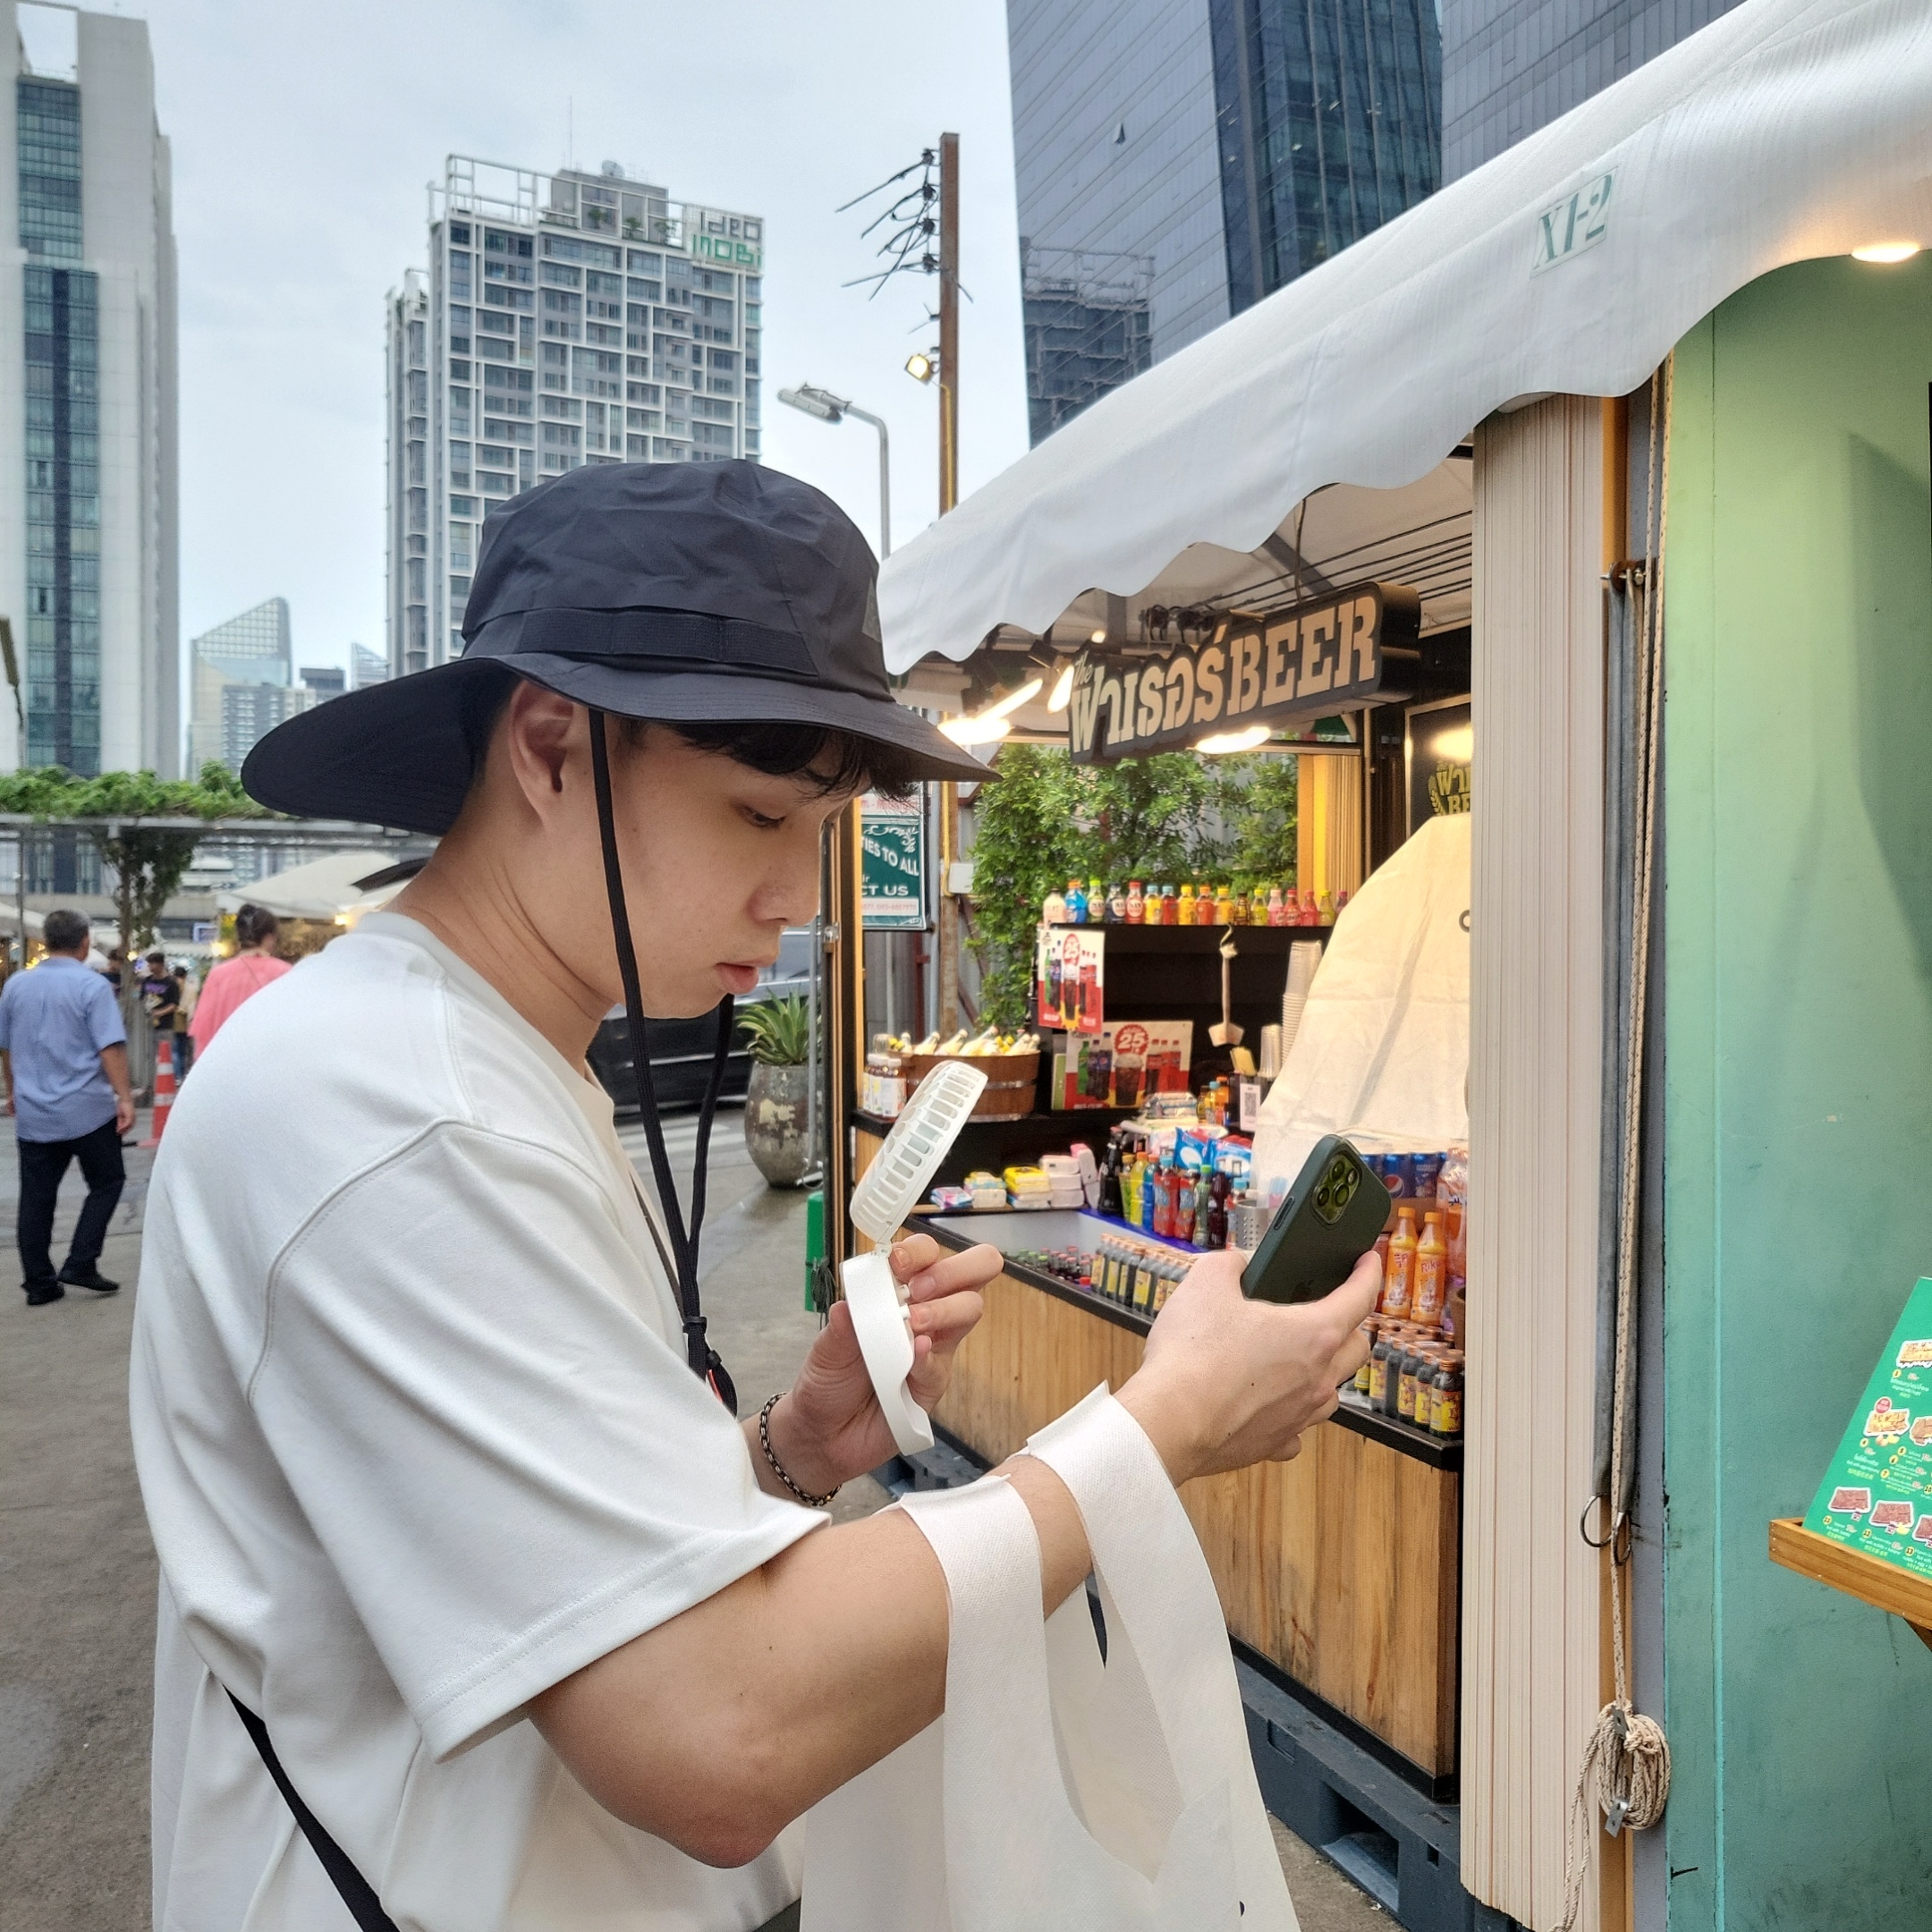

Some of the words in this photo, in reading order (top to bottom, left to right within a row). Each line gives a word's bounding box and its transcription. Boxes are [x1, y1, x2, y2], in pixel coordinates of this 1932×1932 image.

[1073, 650, 1093, 686] the
[1226, 596, 1378, 715] BEER
[881, 846, 898, 867] TO
[900, 856, 919, 877] ALL
[884, 885, 909, 896] US
[1117, 1031, 1146, 1050] 25
